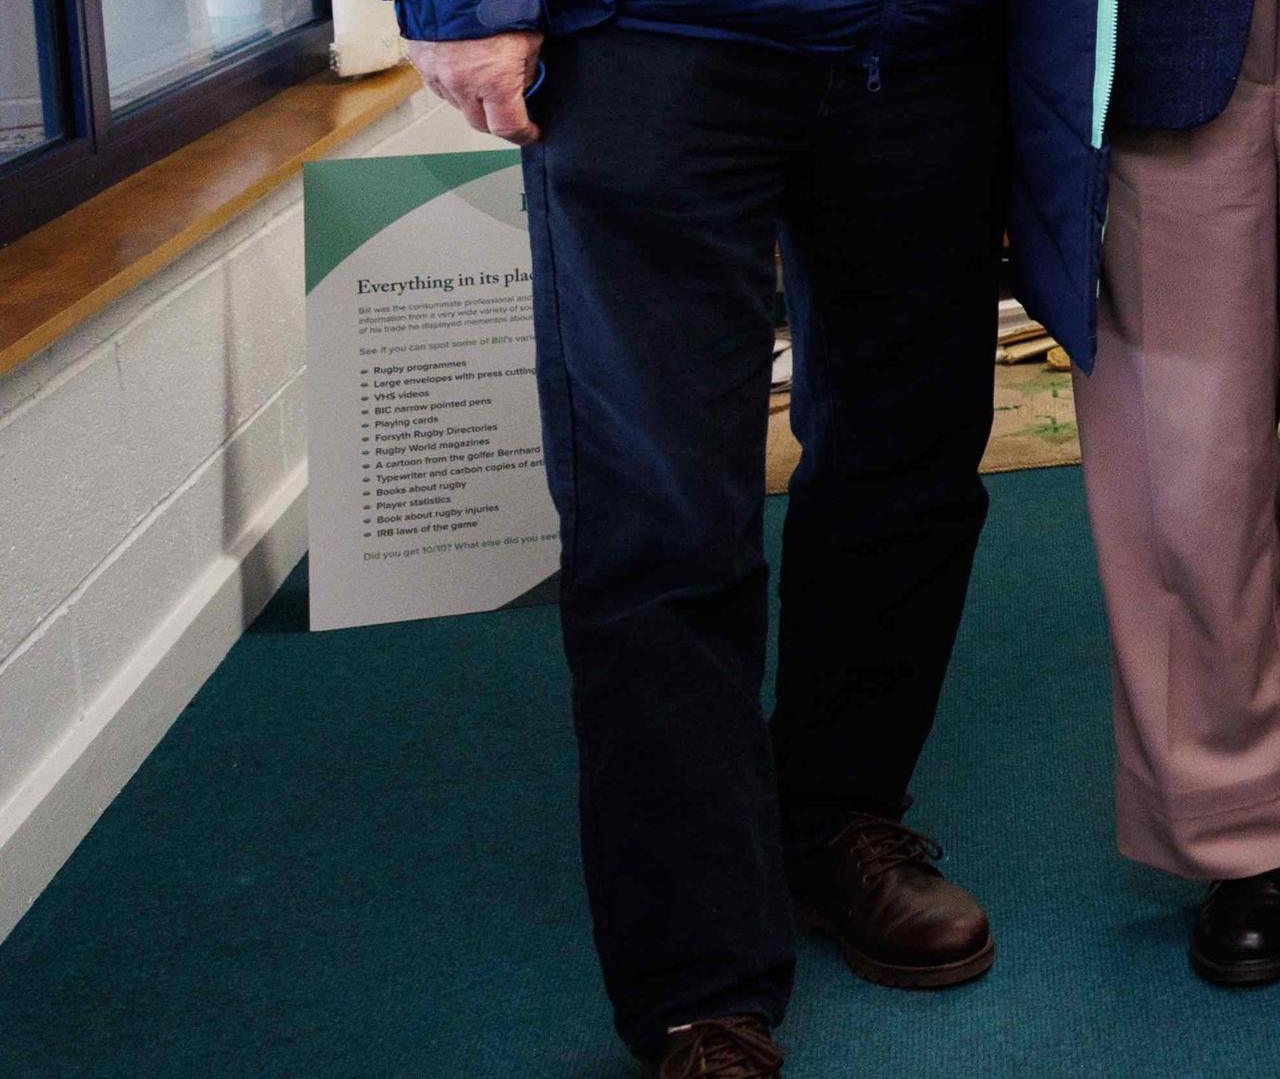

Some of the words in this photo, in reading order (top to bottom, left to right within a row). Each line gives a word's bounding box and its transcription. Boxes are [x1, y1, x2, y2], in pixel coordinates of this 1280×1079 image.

[357, 275, 454, 296] Everything
[459, 274, 474, 286] in
[479, 272, 499, 285] its
[374, 366, 404, 375] Rugby
[406, 360, 467, 373] programmes
[374, 393, 396, 401] VHS
[398, 390, 429, 399] videos
[375, 406, 392, 415] BIC
[394, 404, 428, 413] narrow
[430, 400, 467, 411] pointed
[469, 398, 492, 408] pens
[375, 419, 410, 429] Playing
[412, 416, 439, 425] cards
[376, 487, 407, 497] Books
[408, 484, 437, 493] about
[439, 480, 467, 490] rugby
[376, 501, 407, 511] Player
[409, 497, 452, 507] statistics
